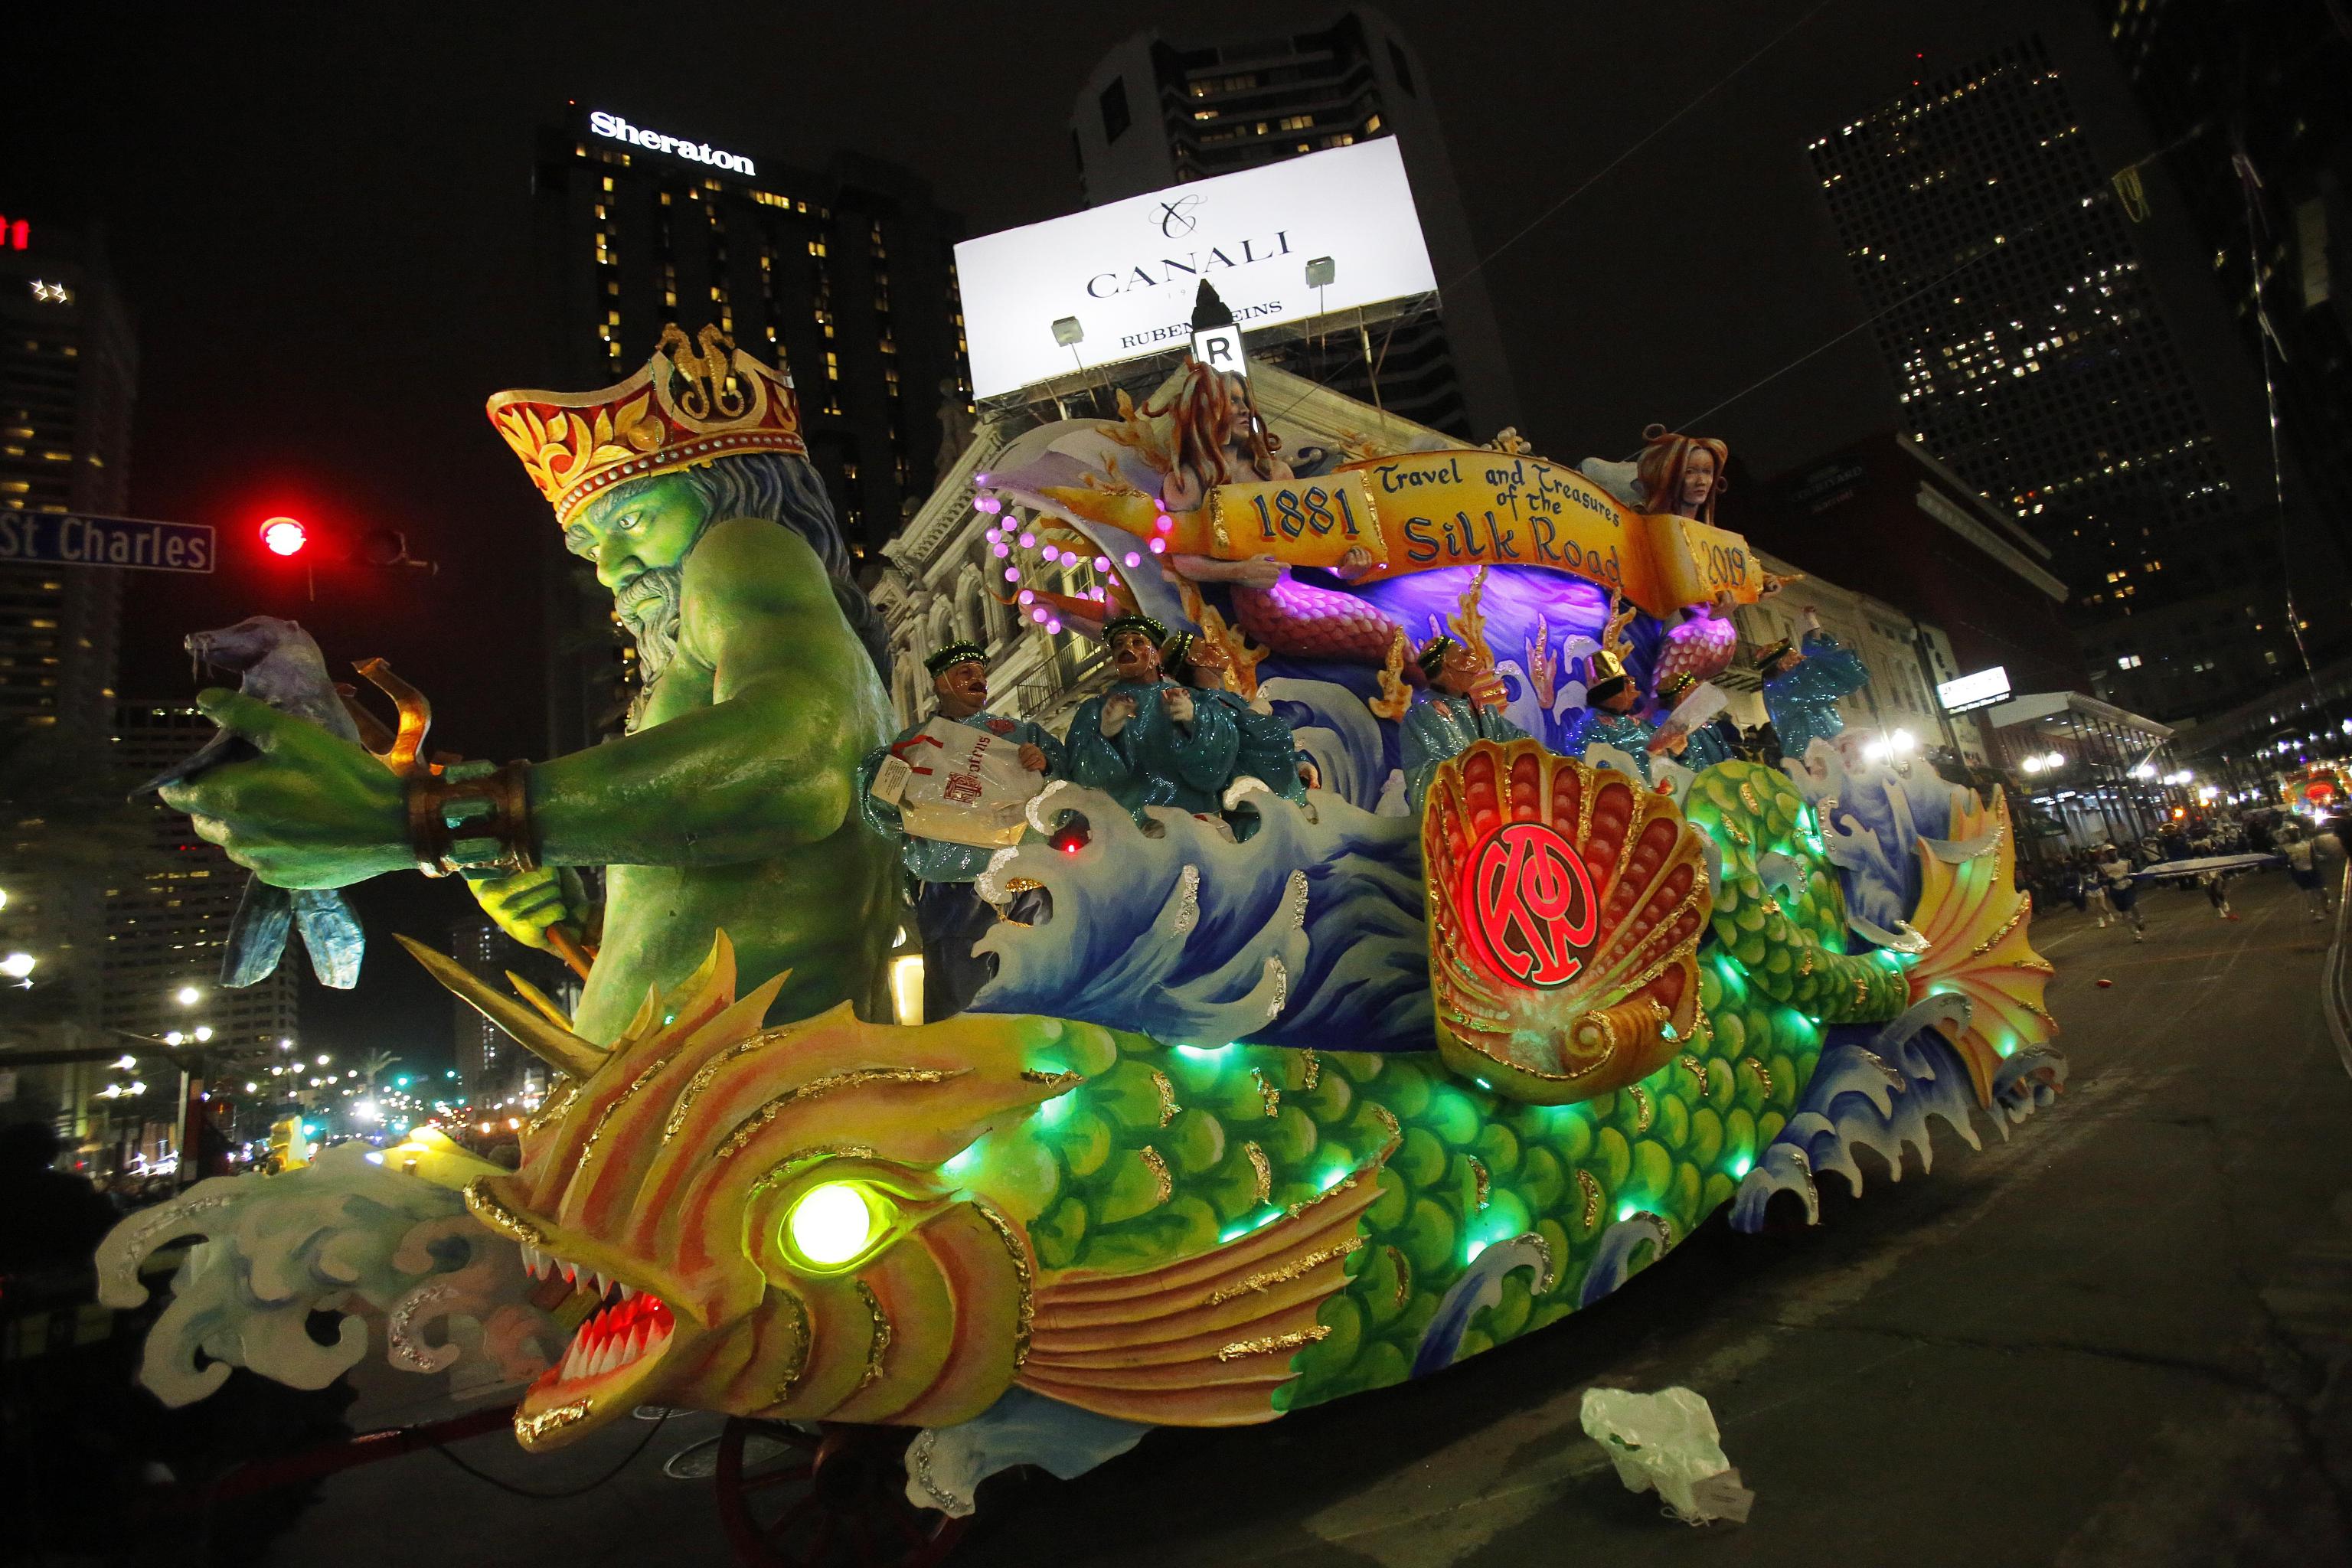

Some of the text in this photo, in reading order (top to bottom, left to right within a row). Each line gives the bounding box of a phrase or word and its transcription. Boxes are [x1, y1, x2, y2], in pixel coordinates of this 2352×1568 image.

[590, 111, 756, 176] Sheraton
[1086, 230, 1294, 299] CANALI
[1120, 300, 1283, 349] RUBENEINS
[1206, 337, 1233, 364] R
[1253, 486, 1361, 538] 1881
[1374, 458, 1620, 528] Travel and Treasures
[1497, 484, 1563, 521] of the
[0, 511, 206, 568] St Charles
[1404, 511, 1624, 588] Silk Road
[1700, 541, 1747, 586] 2019
